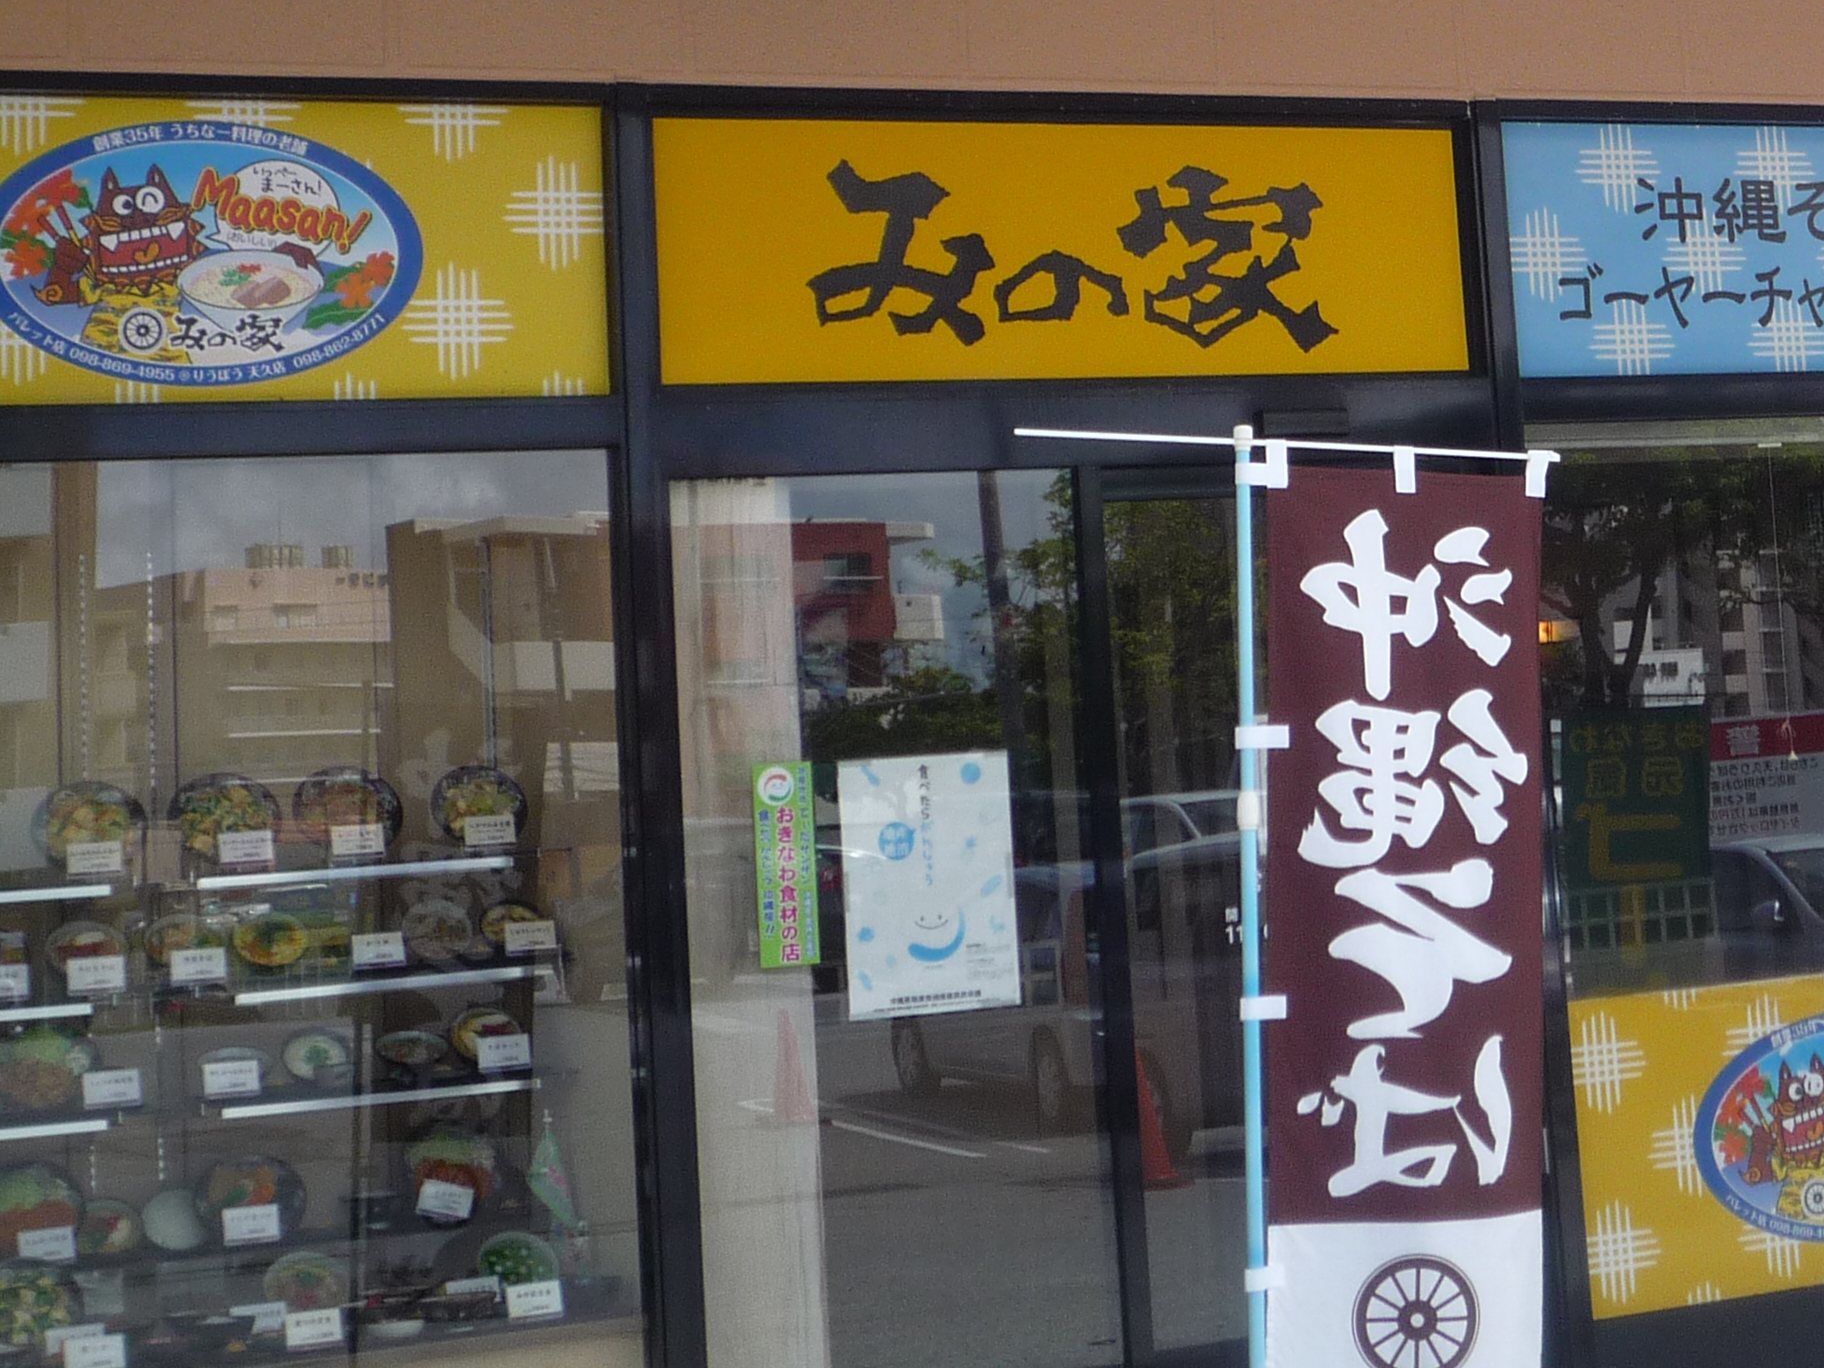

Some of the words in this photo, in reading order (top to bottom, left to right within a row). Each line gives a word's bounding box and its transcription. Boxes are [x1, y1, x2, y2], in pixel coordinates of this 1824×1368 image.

[169, 124, 309, 157] うちなー料理の老舗
[190, 165, 372, 254] Maasan!
[805, 158, 1340, 354] みの家
[776, 806, 801, 964] おきなわ食材の店
